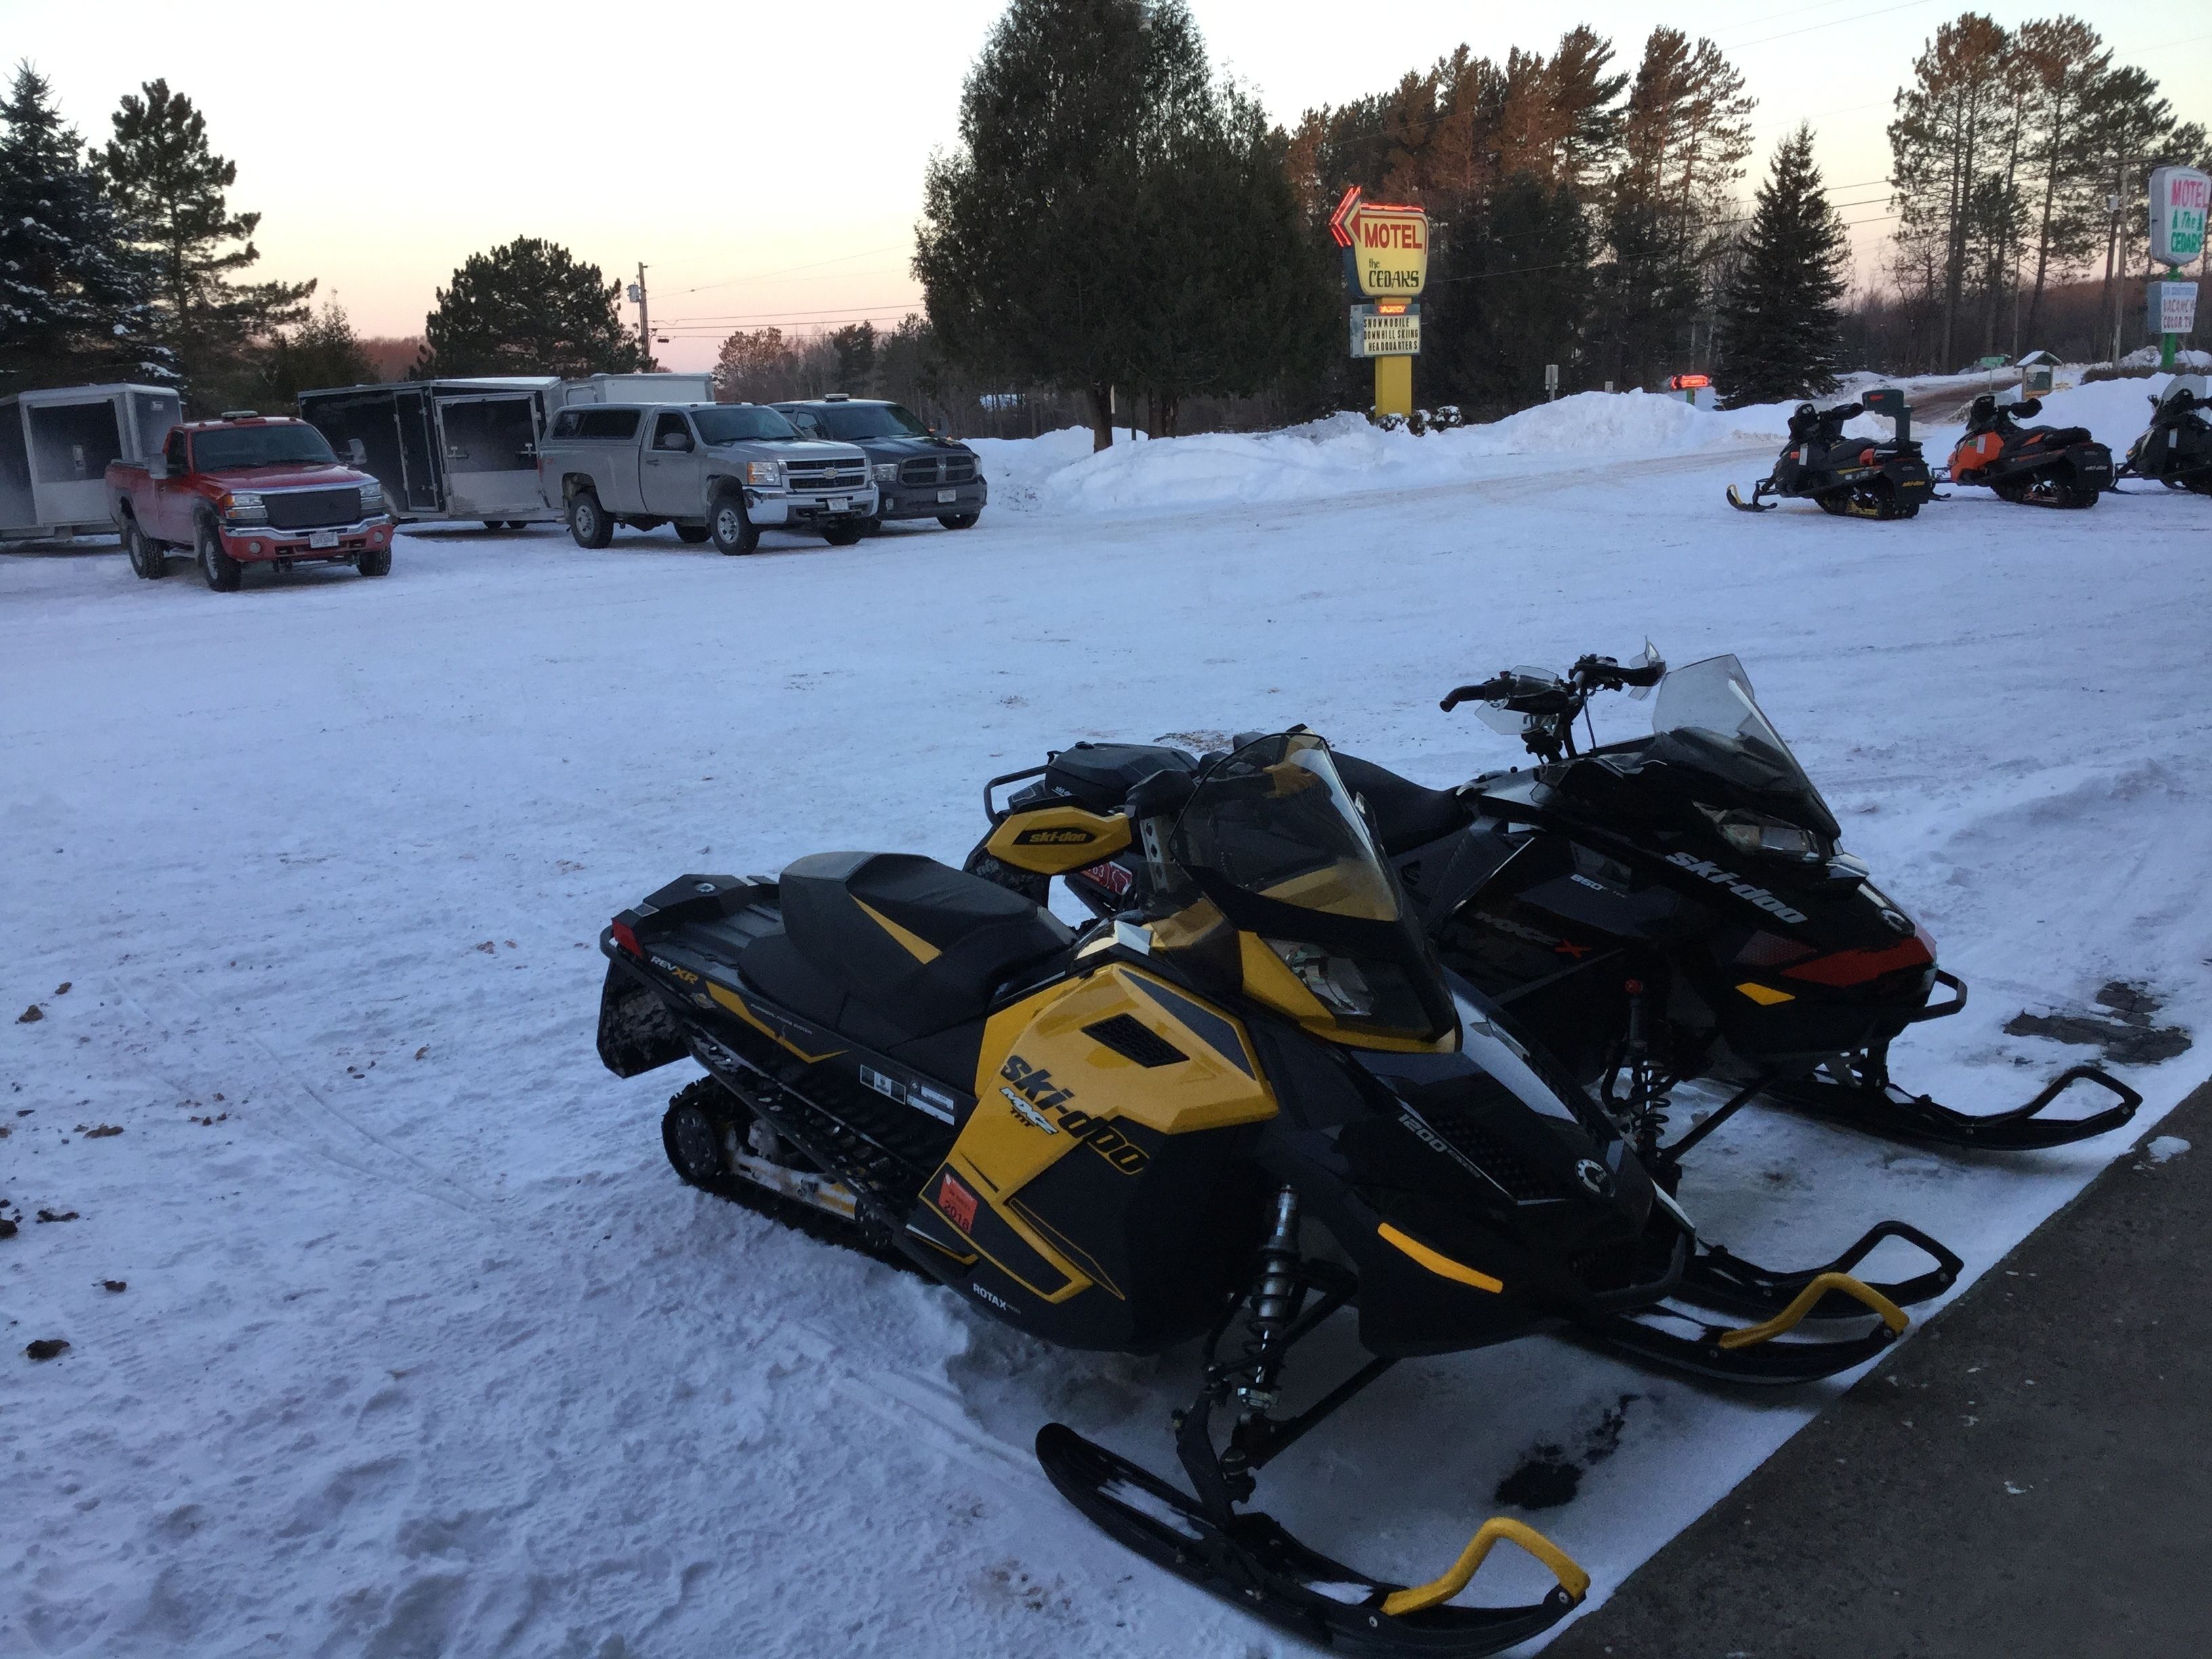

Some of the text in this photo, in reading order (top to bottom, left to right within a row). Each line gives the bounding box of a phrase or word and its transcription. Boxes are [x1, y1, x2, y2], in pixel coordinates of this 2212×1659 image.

[2171, 180, 2208, 207] MOTEL
[2182, 211, 2196, 229] The
[1364, 223, 1422, 249] MOTEL
[2171, 232, 2203, 253] CEDARS
[1369, 258, 1380, 268] the
[1369, 270, 1419, 288] CEDARS
[1364, 317, 1410, 328] SNOWMOBILE
[1364, 329, 1418, 340] DOWNHILL SKIING
[1368, 340, 1418, 352] HEADQUARTERS
[1029, 831, 1087, 842] ski-doo
[1664, 851, 1808, 924] ski-doo
[1000, 1054, 1150, 1175] ski-doo
[1397, 1113, 1448, 1153] 1200
[943, 1200, 970, 1231] 2018
[972, 1282, 1007, 1312] ROTAX
